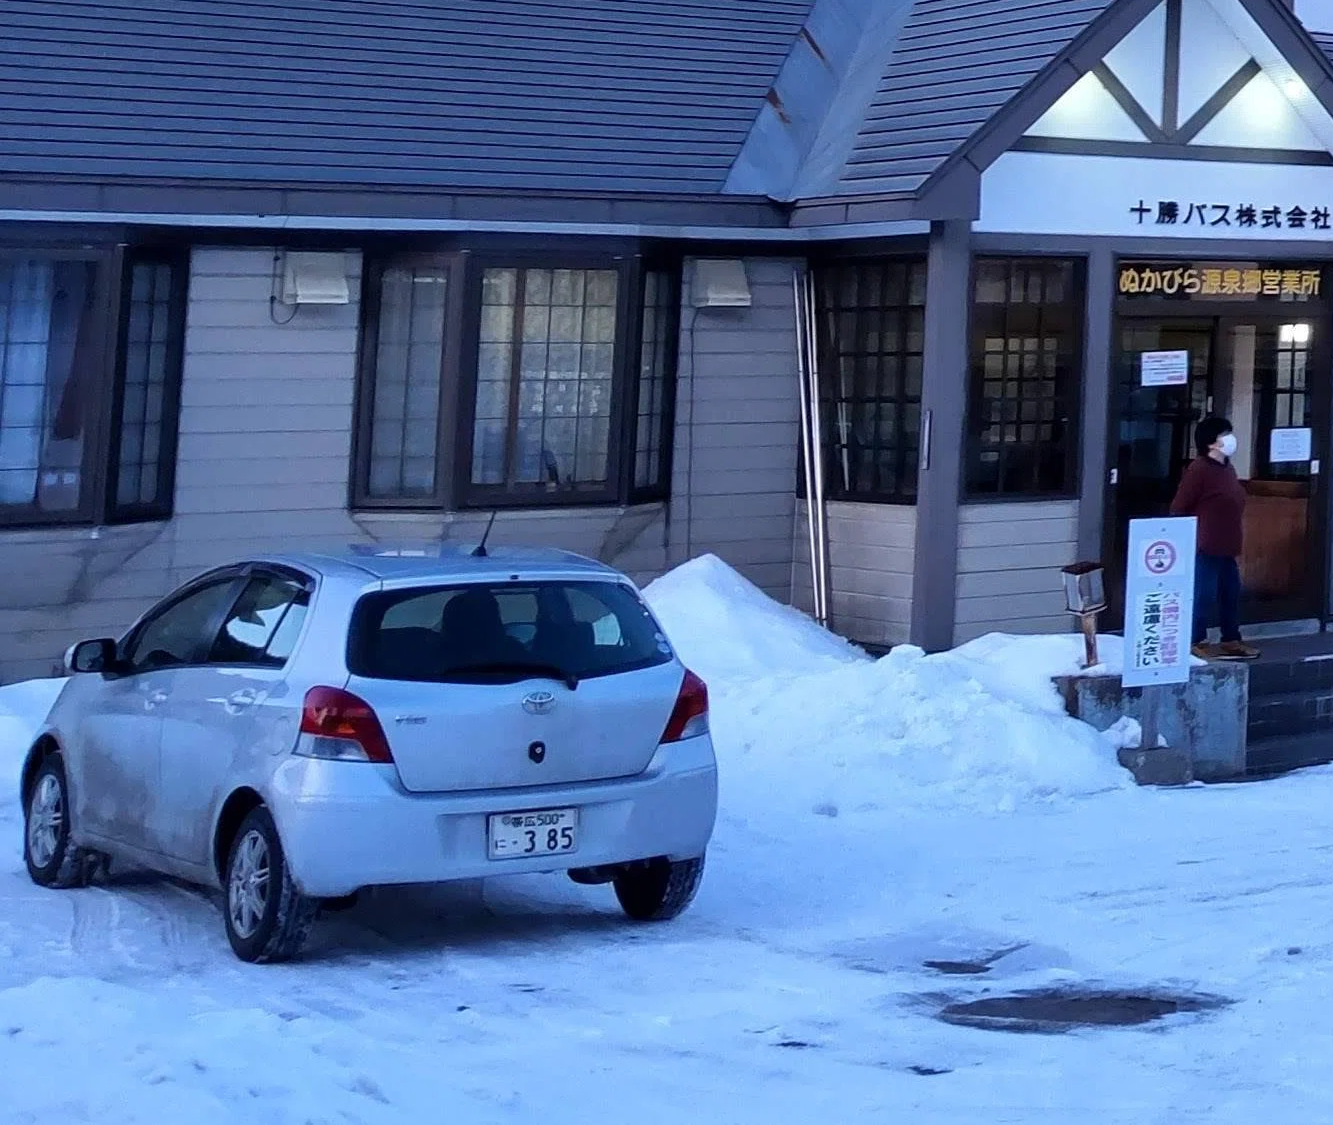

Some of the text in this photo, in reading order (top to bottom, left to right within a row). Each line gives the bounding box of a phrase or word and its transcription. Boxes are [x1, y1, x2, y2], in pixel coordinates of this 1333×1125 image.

[1129, 200, 1331, 229] 十勝バス株式会社
[1119, 268, 1320, 295] ぬかびら源泉郷営業所
